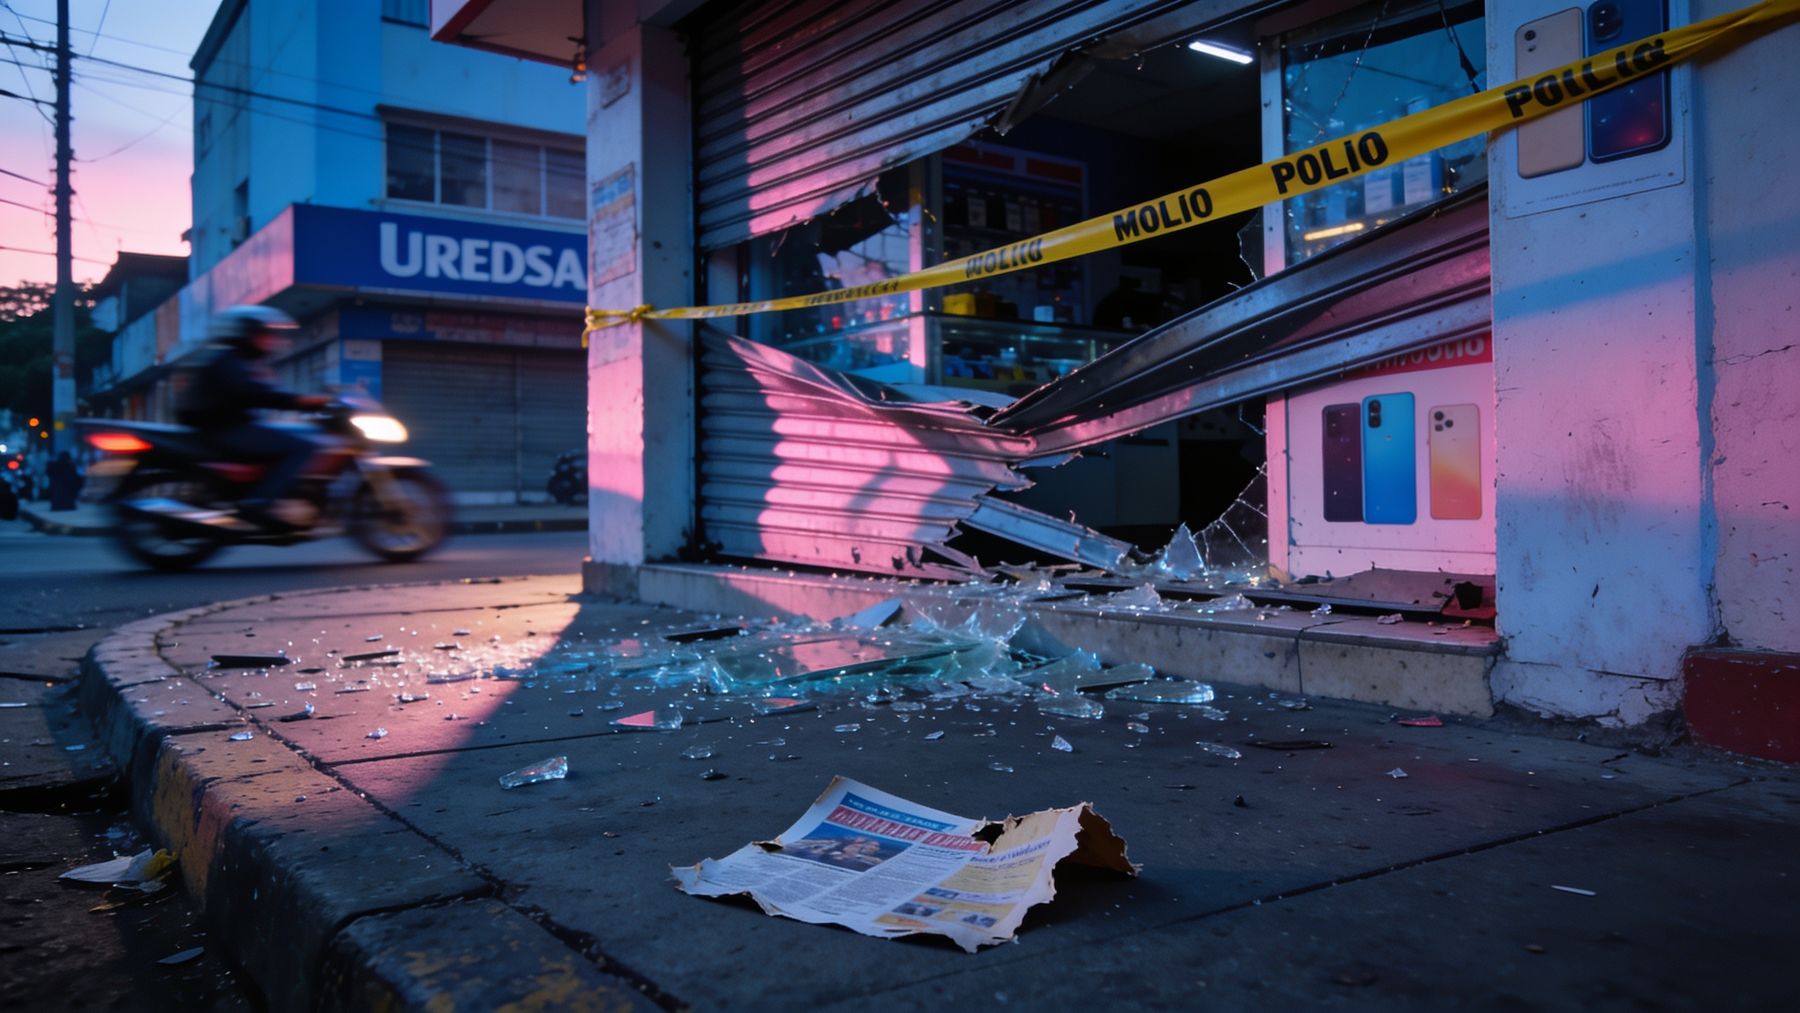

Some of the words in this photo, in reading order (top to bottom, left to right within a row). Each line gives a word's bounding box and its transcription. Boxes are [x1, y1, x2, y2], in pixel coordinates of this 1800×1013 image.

[1113, 188, 1213, 241] MOLIO
[1272, 132, 1388, 194] POLIO
[380, 222, 587, 291] UREDSA
